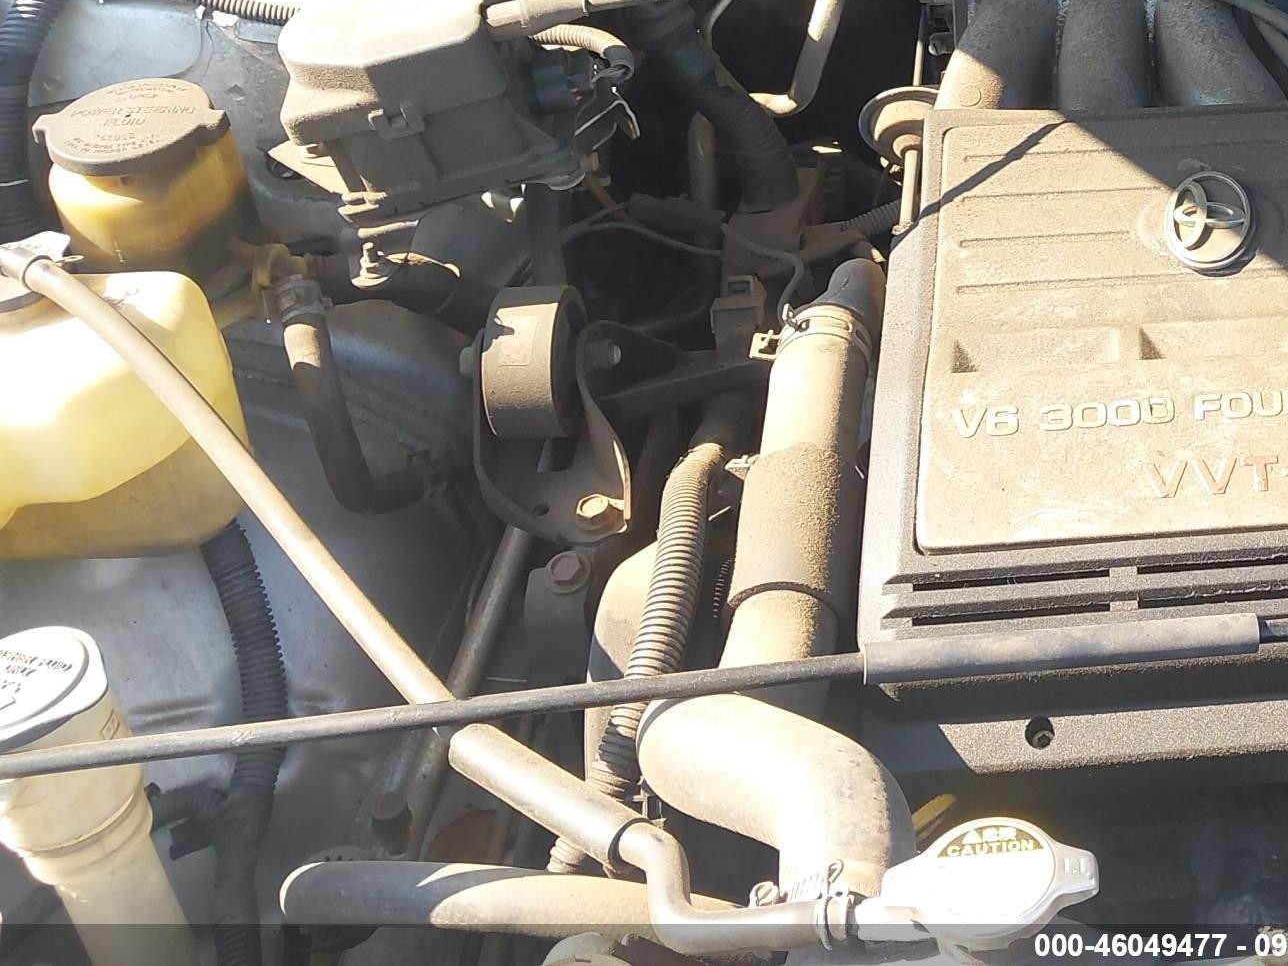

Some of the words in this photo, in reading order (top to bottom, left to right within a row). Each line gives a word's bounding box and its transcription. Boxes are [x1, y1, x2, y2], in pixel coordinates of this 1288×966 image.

[126, 105, 197, 115] STEERING
[953, 404, 1019, 438] V6
[1040, 395, 1176, 432] 3000
[947, 839, 1034, 857] CAUTION
